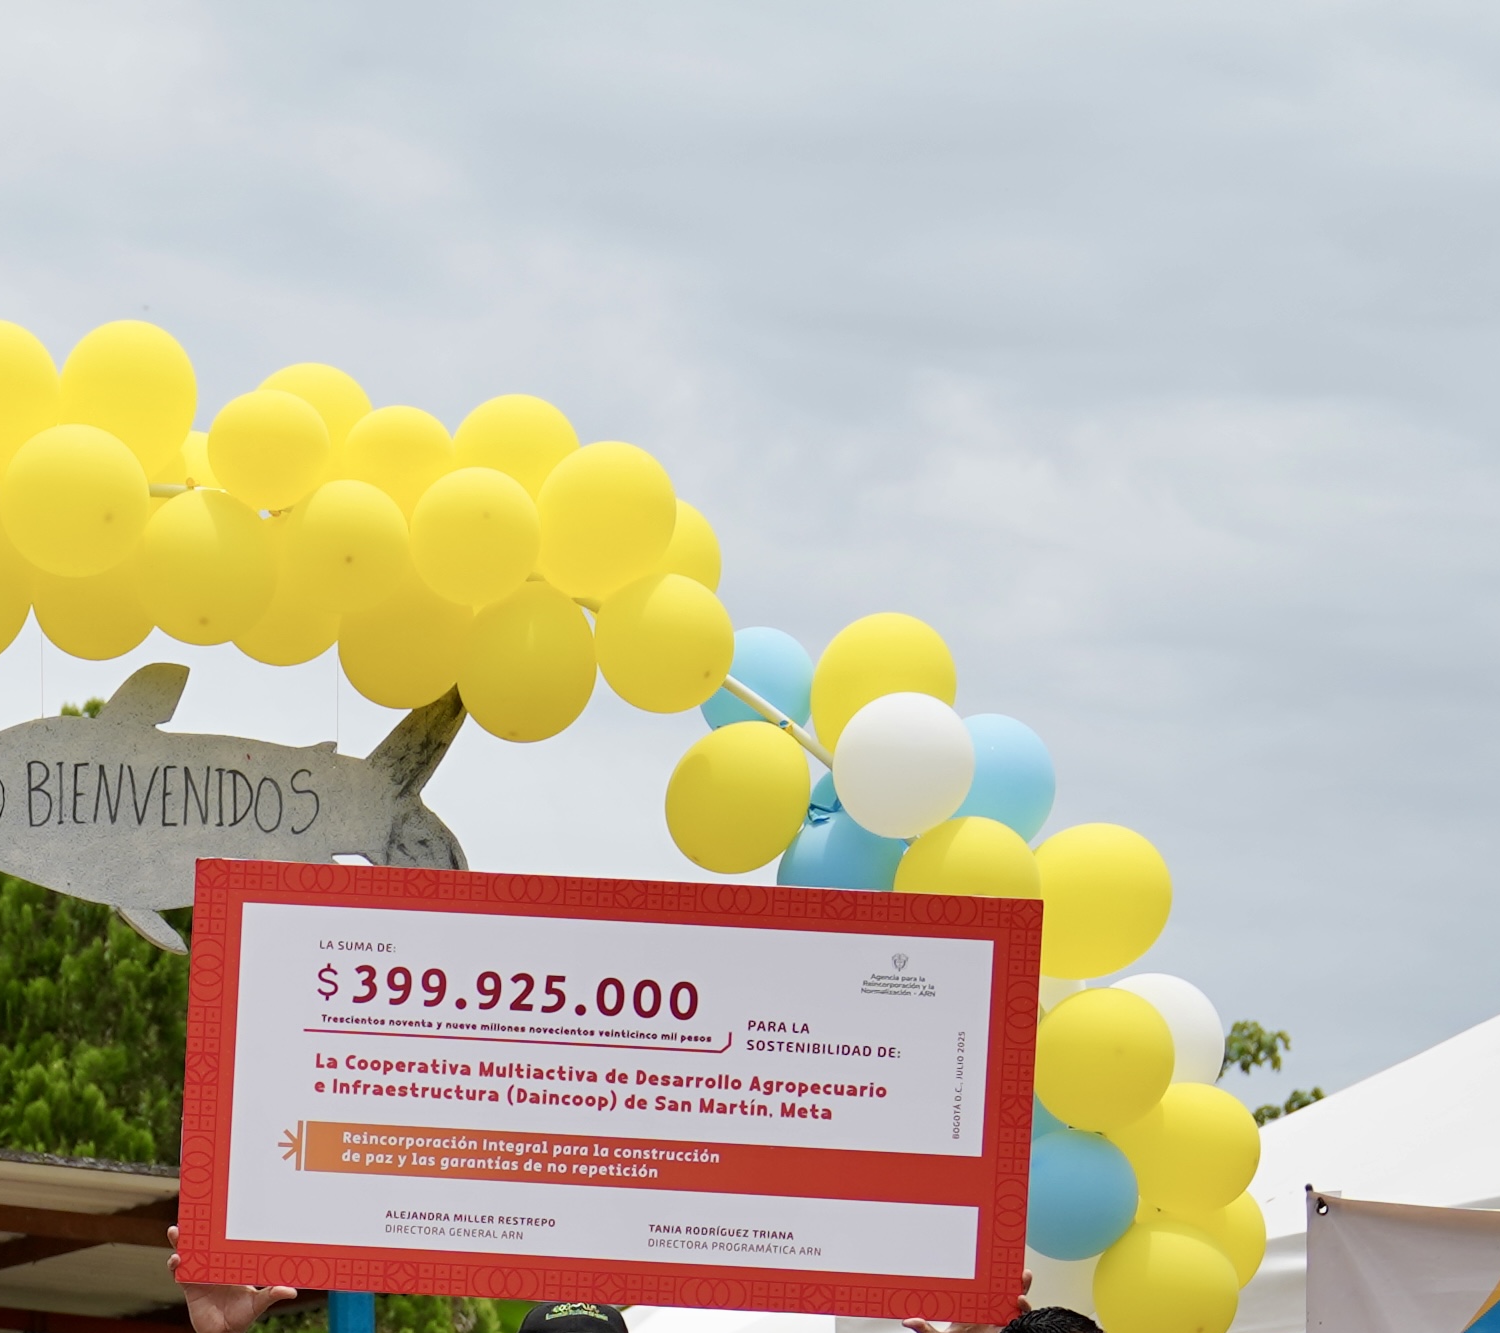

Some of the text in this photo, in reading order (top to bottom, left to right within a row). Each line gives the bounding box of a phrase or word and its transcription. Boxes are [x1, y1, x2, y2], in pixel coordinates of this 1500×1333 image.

[27, 759, 319, 834] BIENVENIDOS
[747, 1019, 810, 1034] PARA LA
[746, 1039, 872, 1057] SOSTENIBILIDAD
